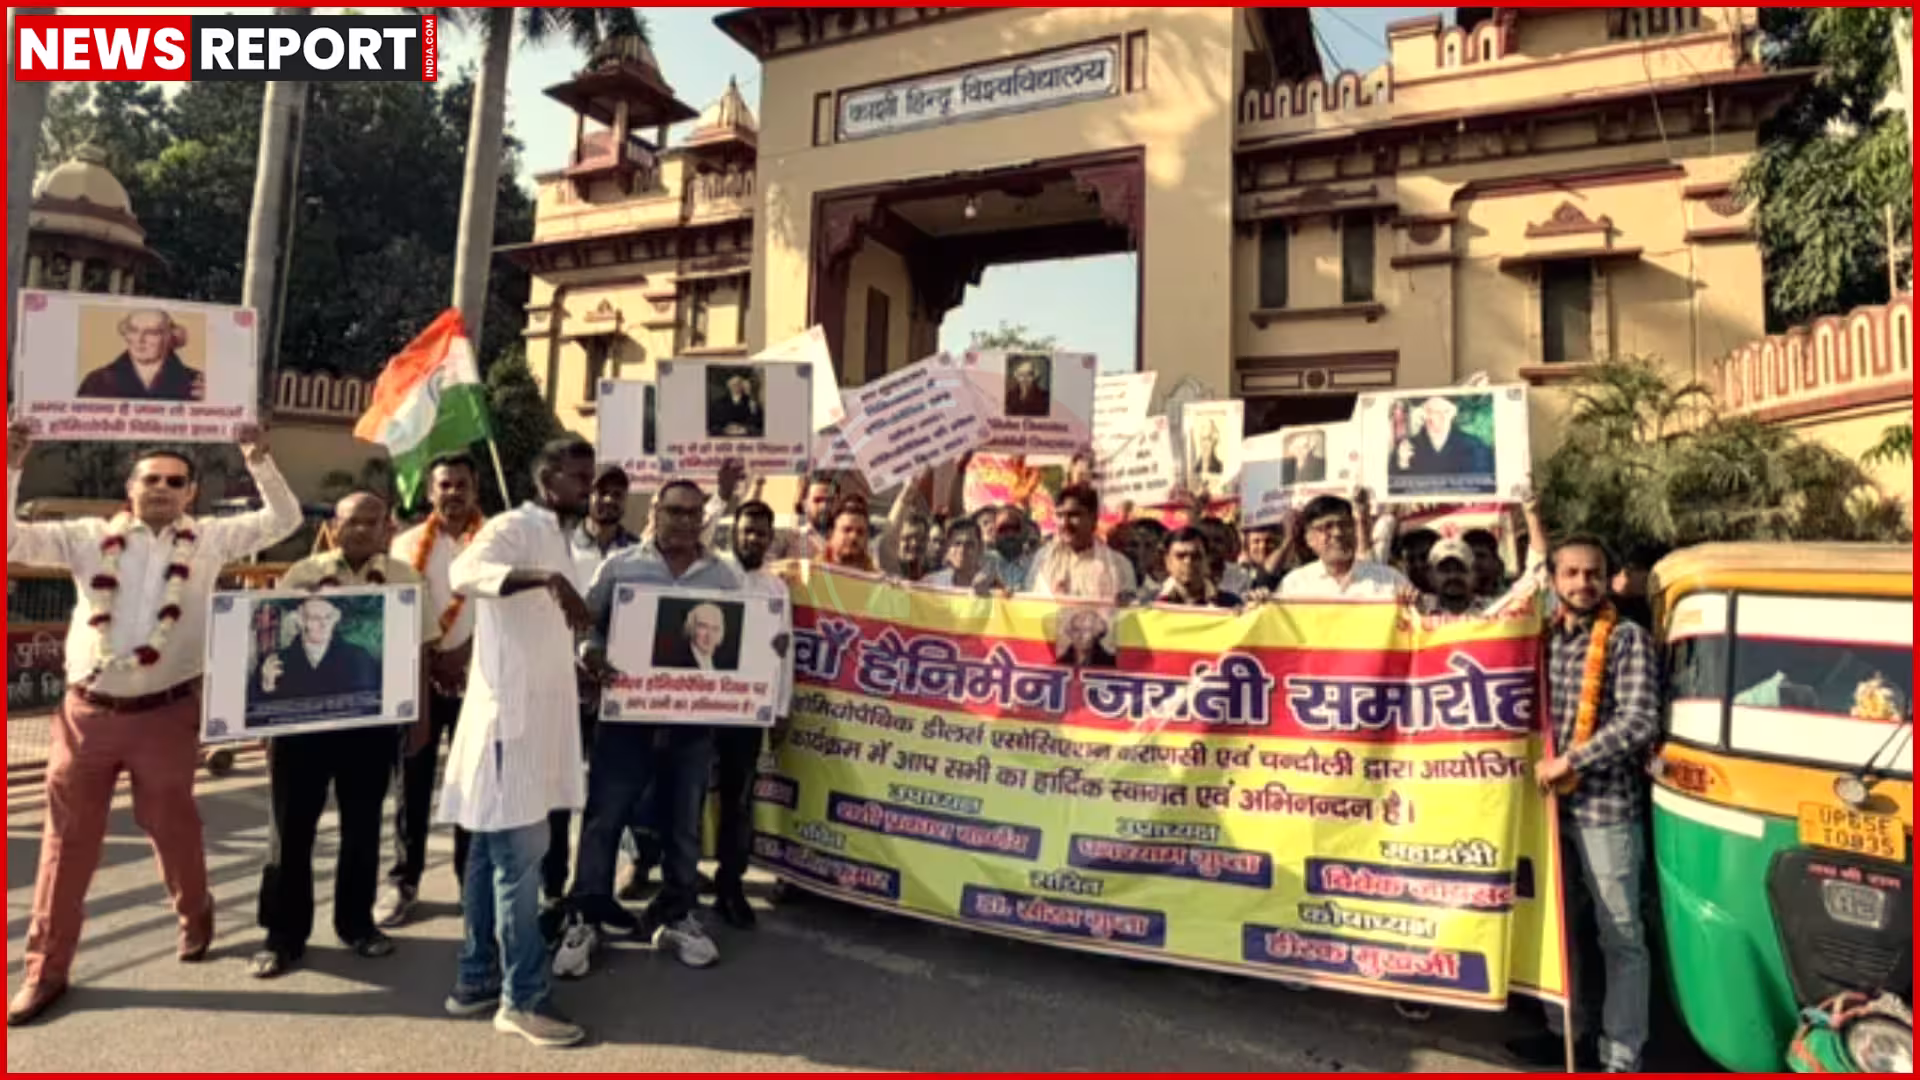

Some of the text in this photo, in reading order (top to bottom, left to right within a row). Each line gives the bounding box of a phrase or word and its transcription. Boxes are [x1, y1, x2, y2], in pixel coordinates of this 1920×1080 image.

[960, 56, 1107, 104] विश्वविद्यालय
[857, 627, 1073, 713] हैनिमैन
[1081, 652, 1274, 727] जयंती
[867, 739, 894, 765] में
[894, 748, 940, 775] आप
[944, 756, 989, 784] सभी
[995, 765, 1027, 791] का
